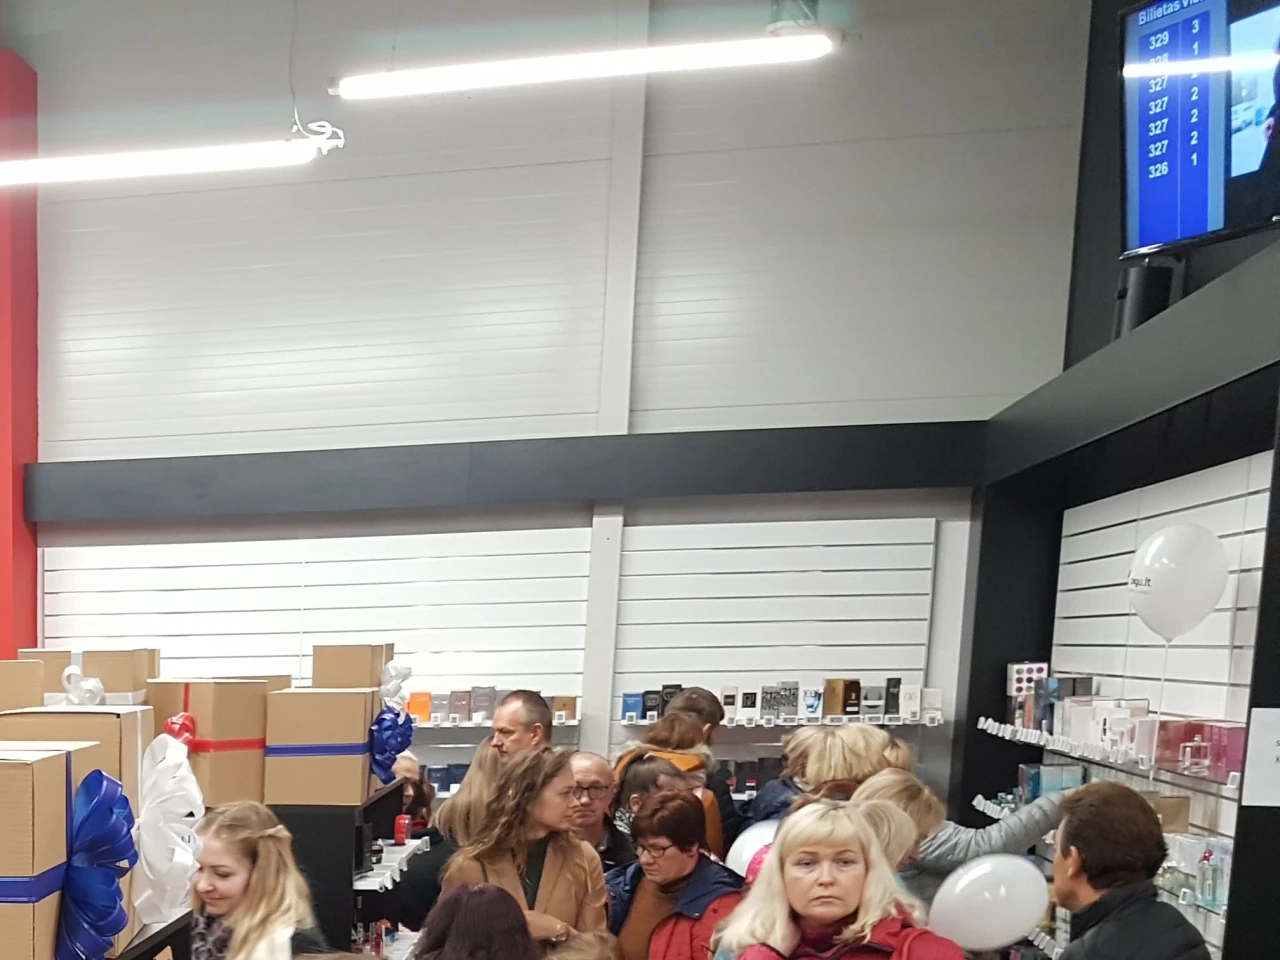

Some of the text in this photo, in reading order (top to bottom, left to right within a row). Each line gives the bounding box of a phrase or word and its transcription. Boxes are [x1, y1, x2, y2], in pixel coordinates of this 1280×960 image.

[1138, 1, 1180, 26] Bilietas
[1148, 19, 1199, 50] 329 3
[1192, 41, 1199, 56] 1
[1148, 74, 1169, 93] 327
[1191, 86, 1199, 101] 2
[1148, 96, 1199, 123] 327 2
[1148, 118, 1199, 145] 327 2
[1148, 140, 1198, 166] 327 1
[1148, 161, 1169, 179] 326
